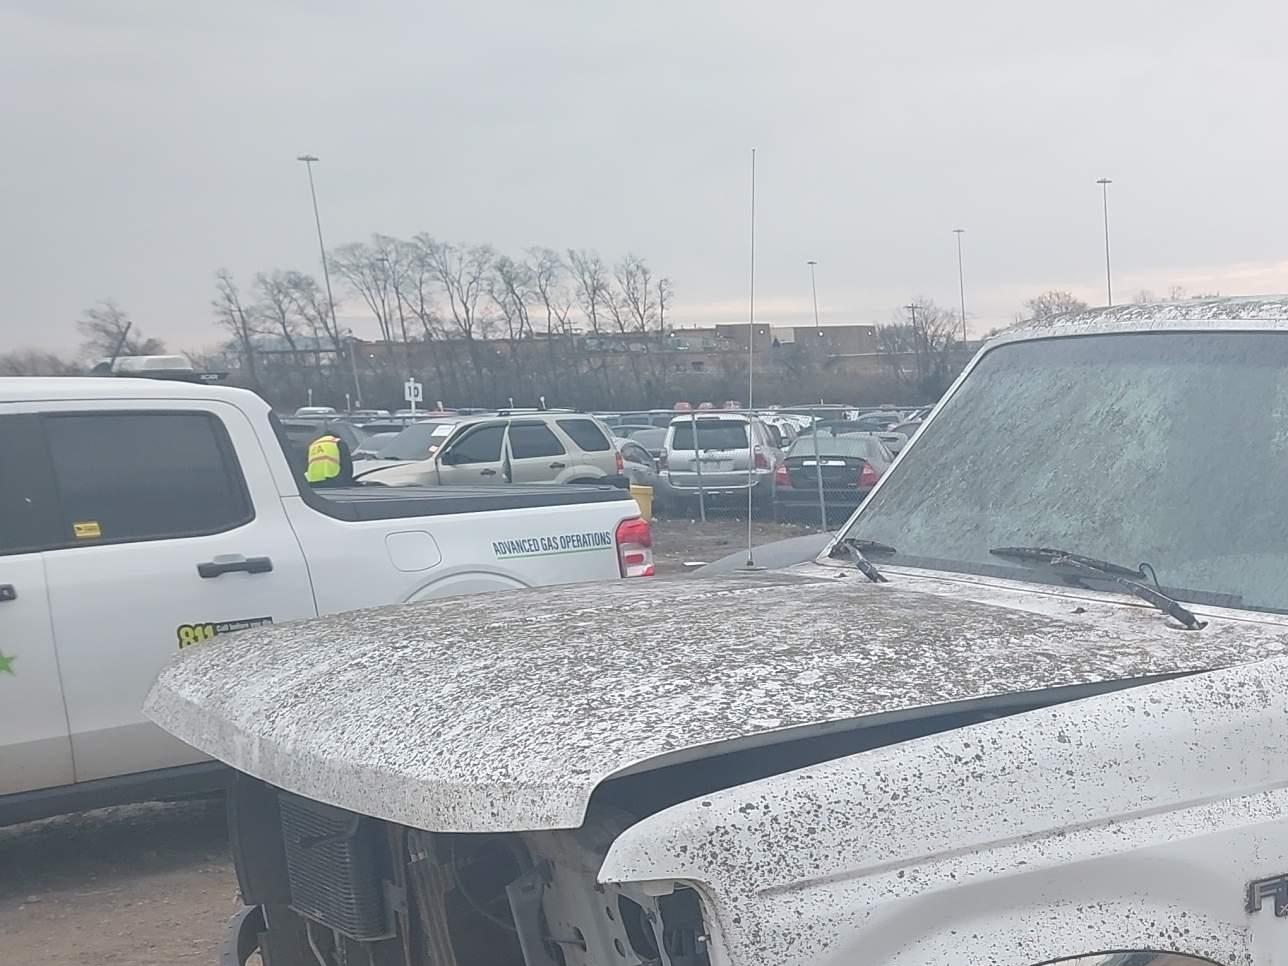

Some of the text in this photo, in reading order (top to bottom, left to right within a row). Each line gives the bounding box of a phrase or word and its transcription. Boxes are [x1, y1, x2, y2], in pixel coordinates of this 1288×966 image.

[492, 531, 612, 556] ADVANCED GAS OPERATIONS
